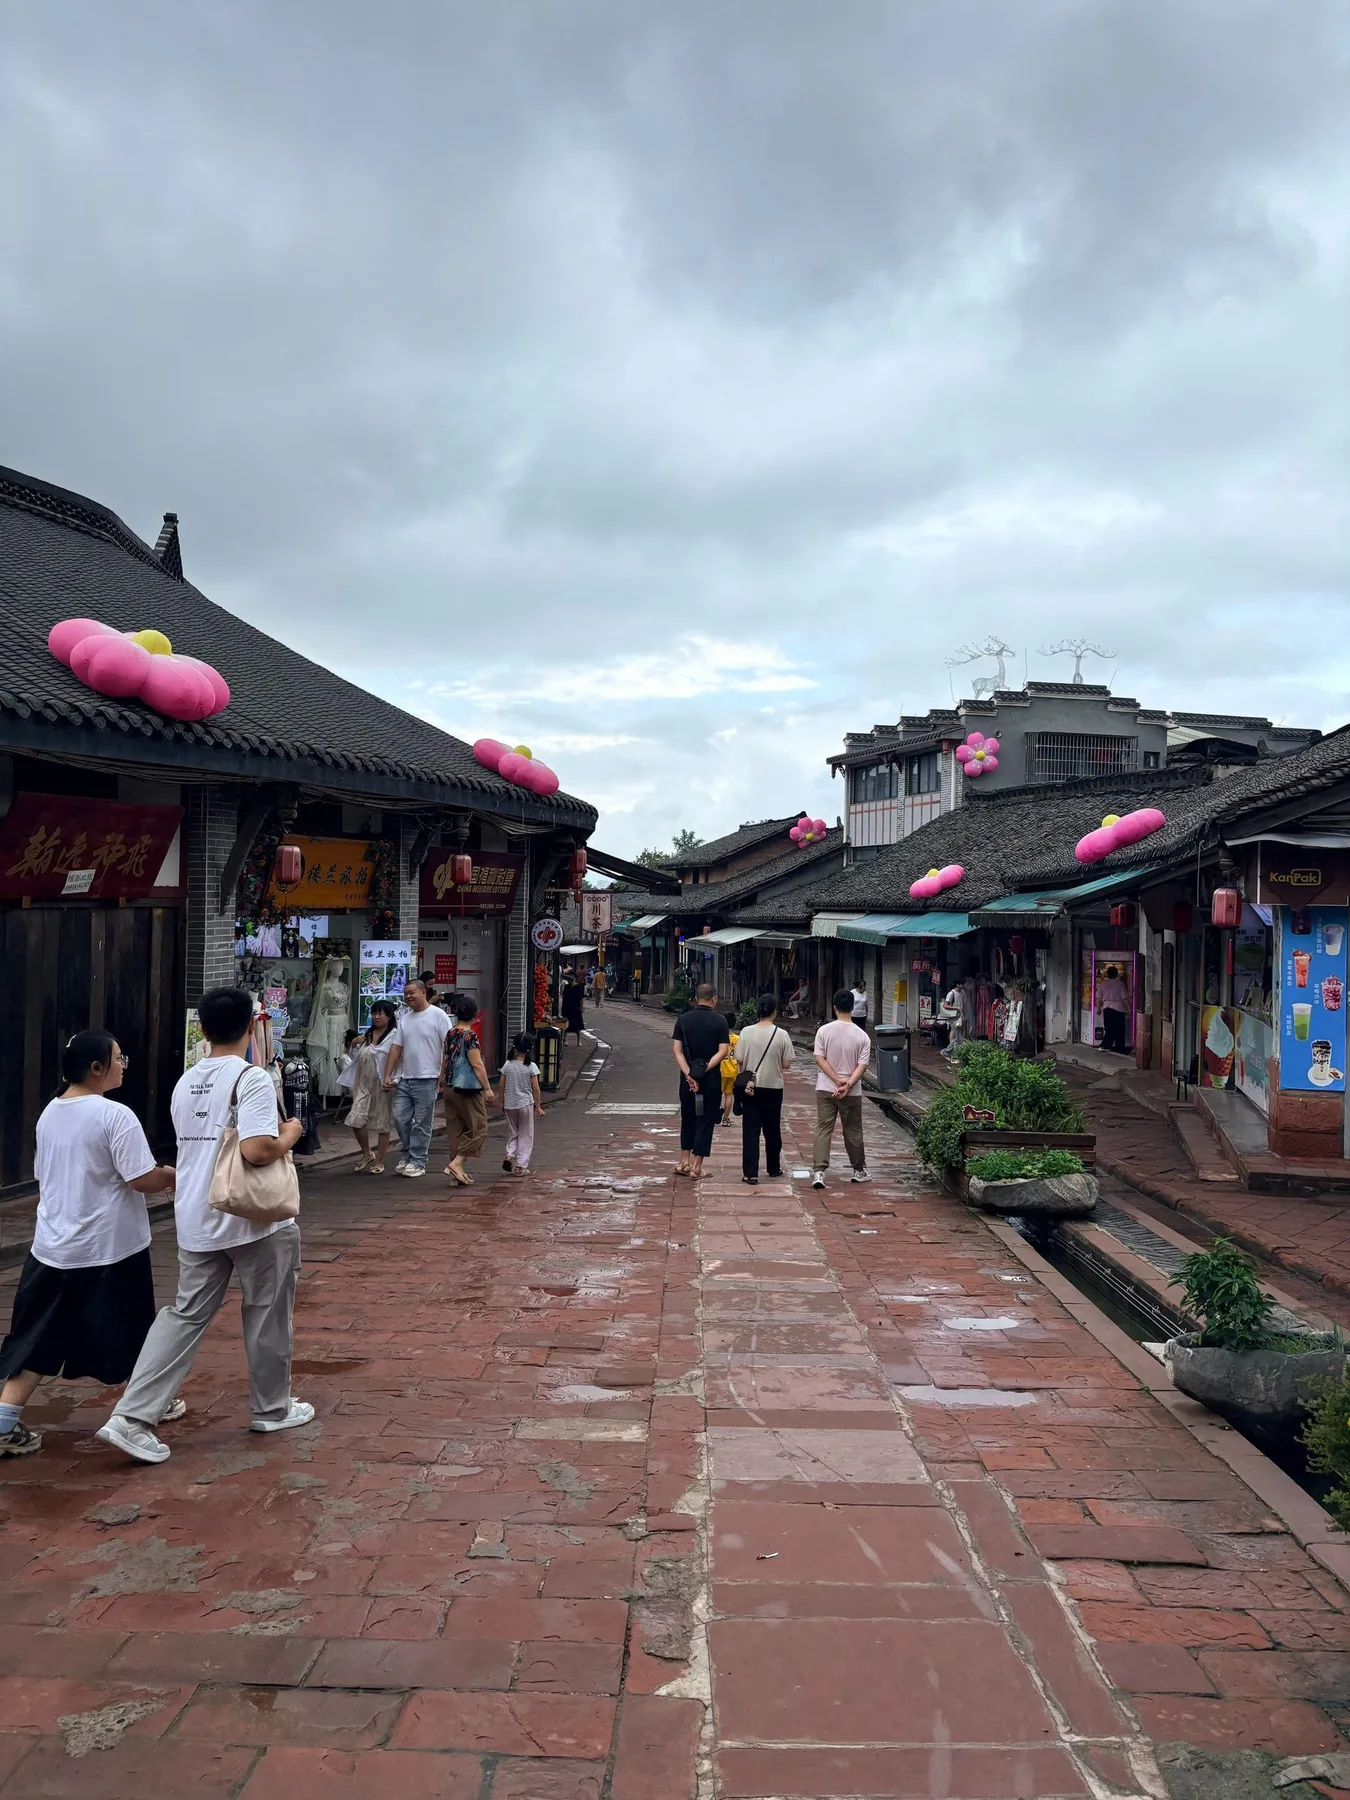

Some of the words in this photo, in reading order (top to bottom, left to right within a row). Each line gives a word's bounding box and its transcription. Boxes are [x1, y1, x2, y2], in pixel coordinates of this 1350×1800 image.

[306, 863, 368, 886] 楼兰旅拍
[470, 865, 516, 885] 国福利彩票
[1269, 871, 1318, 883] KanPak
[591, 903, 602, 930] 川茶
[363, 949, 409, 959] 楼兰旅拍
